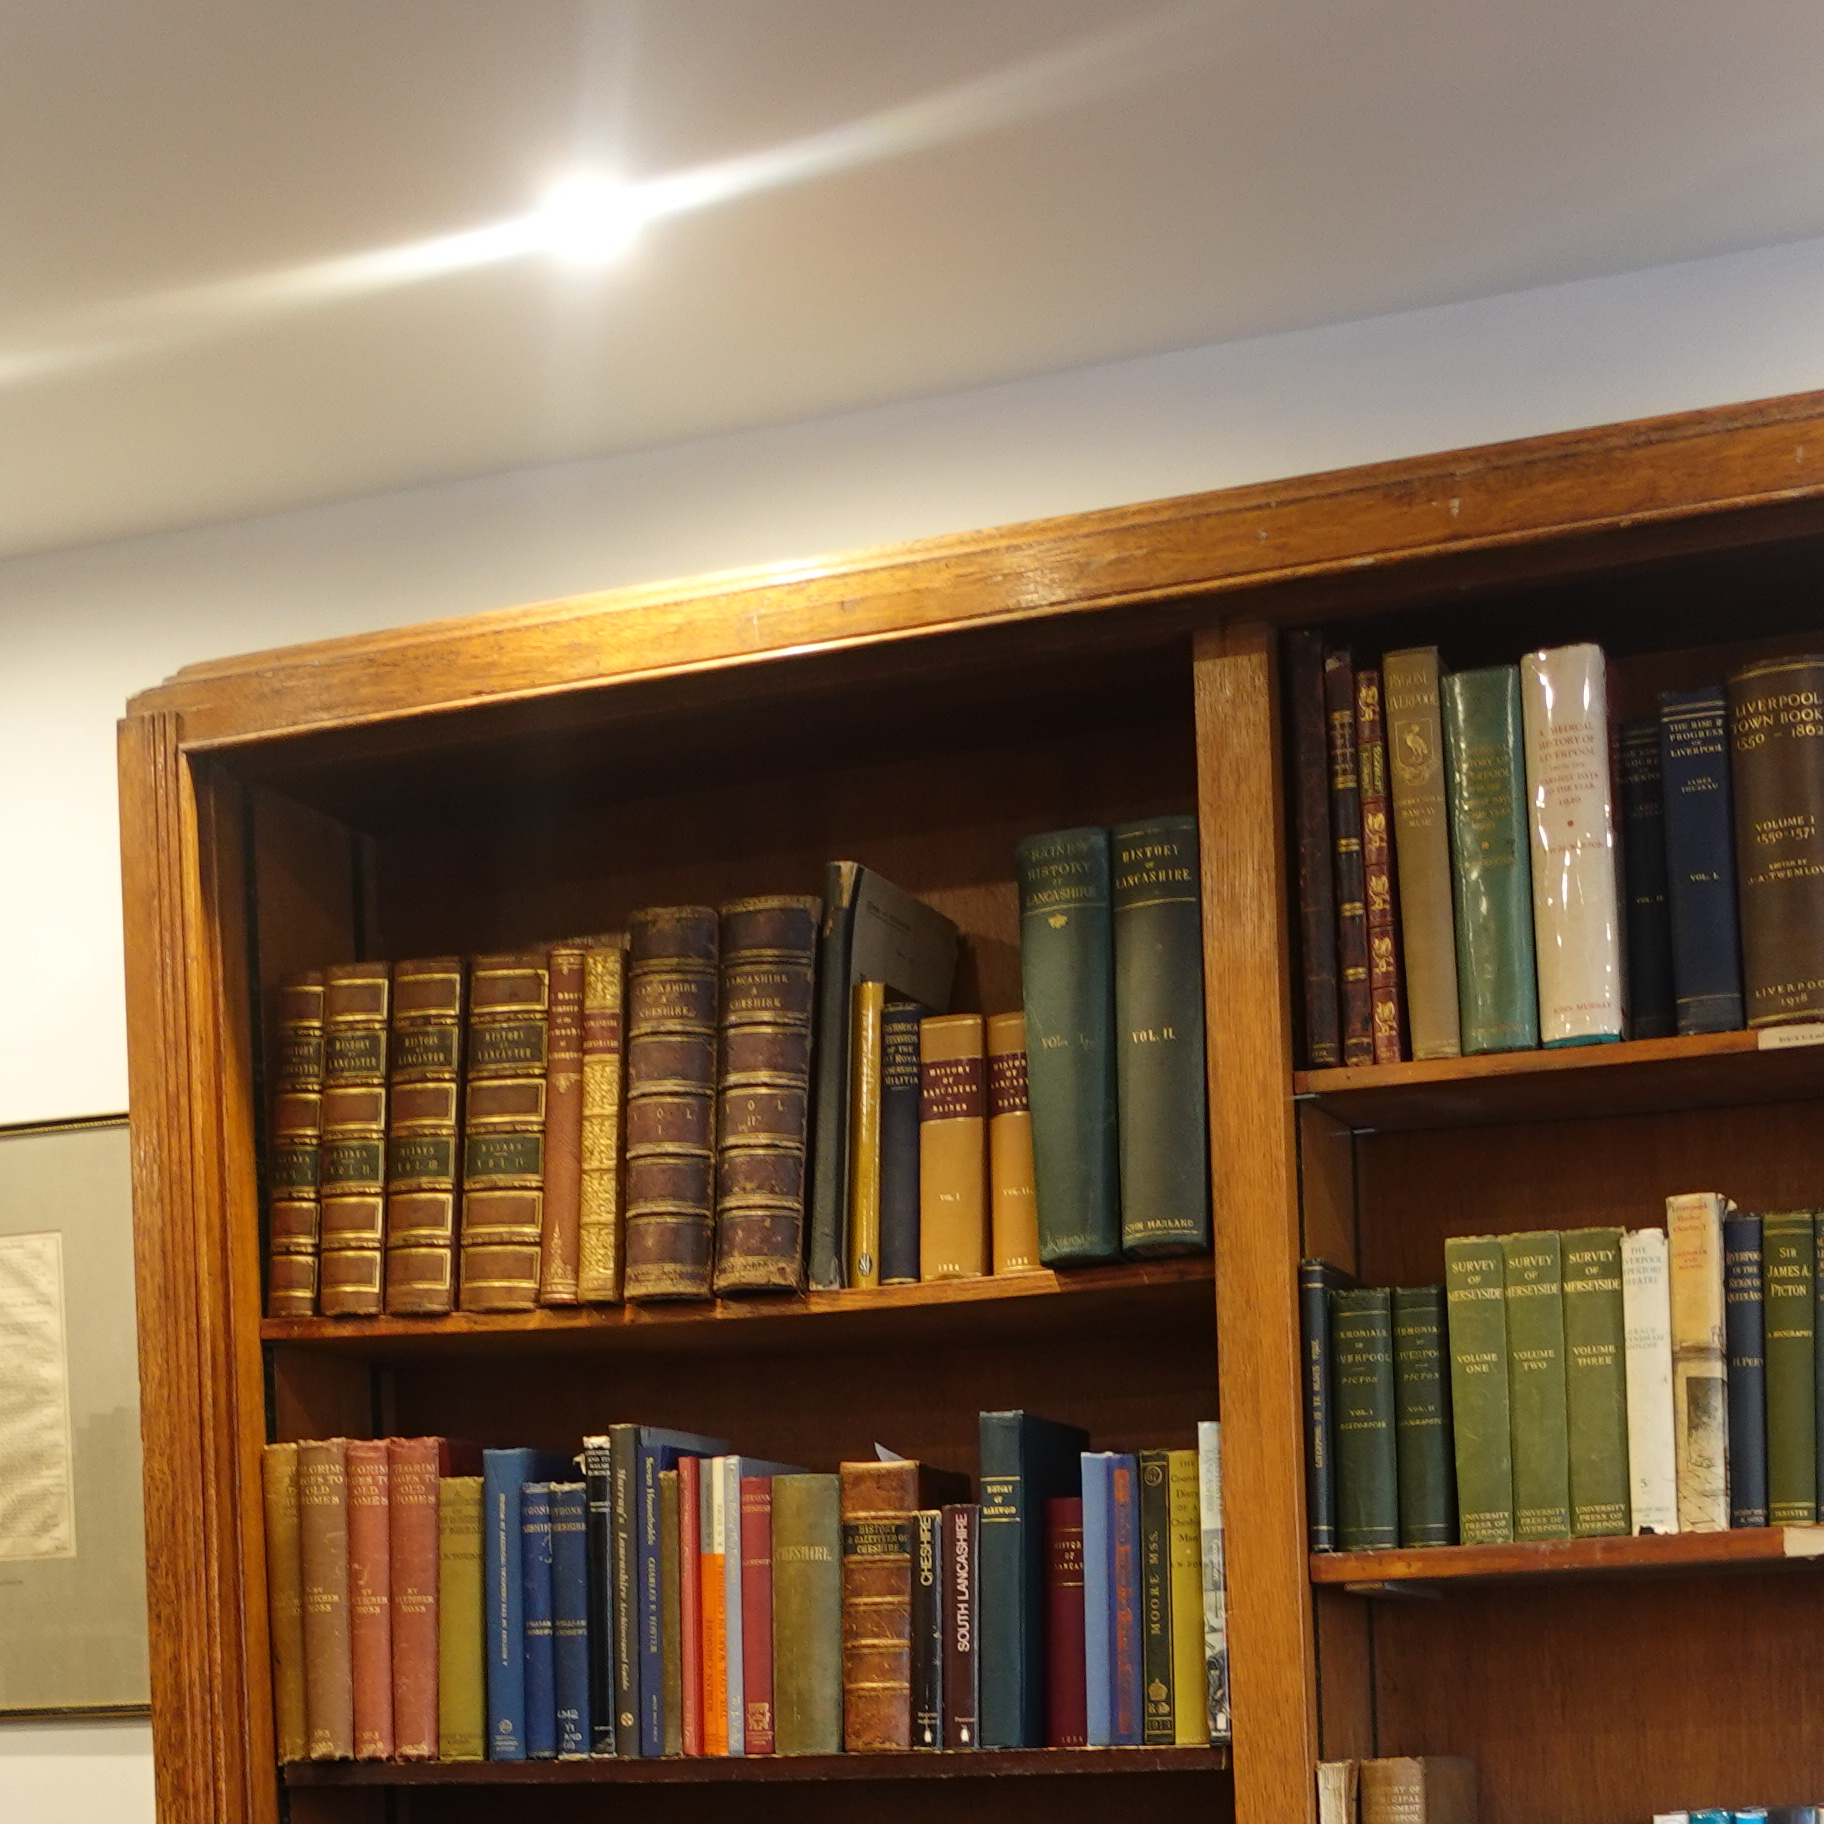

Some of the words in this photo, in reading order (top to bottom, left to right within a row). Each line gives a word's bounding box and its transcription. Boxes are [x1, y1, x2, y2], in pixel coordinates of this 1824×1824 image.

[1735, 692, 1823, 716] LIVERPOOL
[1730, 715, 1774, 735] TOWN
[1736, 734, 1765, 750] 1550
[1755, 816, 1805, 832] VOLUME
[1121, 844, 1180, 862] HISTORY
[1569, 1251, 1615, 1263] SURVEY
[1779, 1247, 1797, 1259] SIR
[1452, 1261, 1497, 1272] SURVEY
[1508, 1255, 1553, 1268] SURVEY
[1525, 1271, 1539, 1280] OF
[1586, 1266, 1600, 1275] OF
[1766, 1266, 1798, 1279] JAMES
[1468, 1275, 1481, 1284] OF
[1770, 1283, 1807, 1298] PICTON
[1513, 1350, 1555, 1361] VOLUME
[1572, 1345, 1616, 1356] VOLUME
[1457, 1353, 1498, 1364] VOLUME
[1577, 1355, 1612, 1366] THREE
[1466, 1364, 1489, 1373] ONE
[1523, 1361, 1547, 1370] TWO
[920, 1516, 933, 1585] CHESHIRE
[955, 1513, 968, 1599] LANCASHIRE
[1149, 1578, 1161, 1636] MOORE
[957, 1602, 971, 1653] SOUTH
